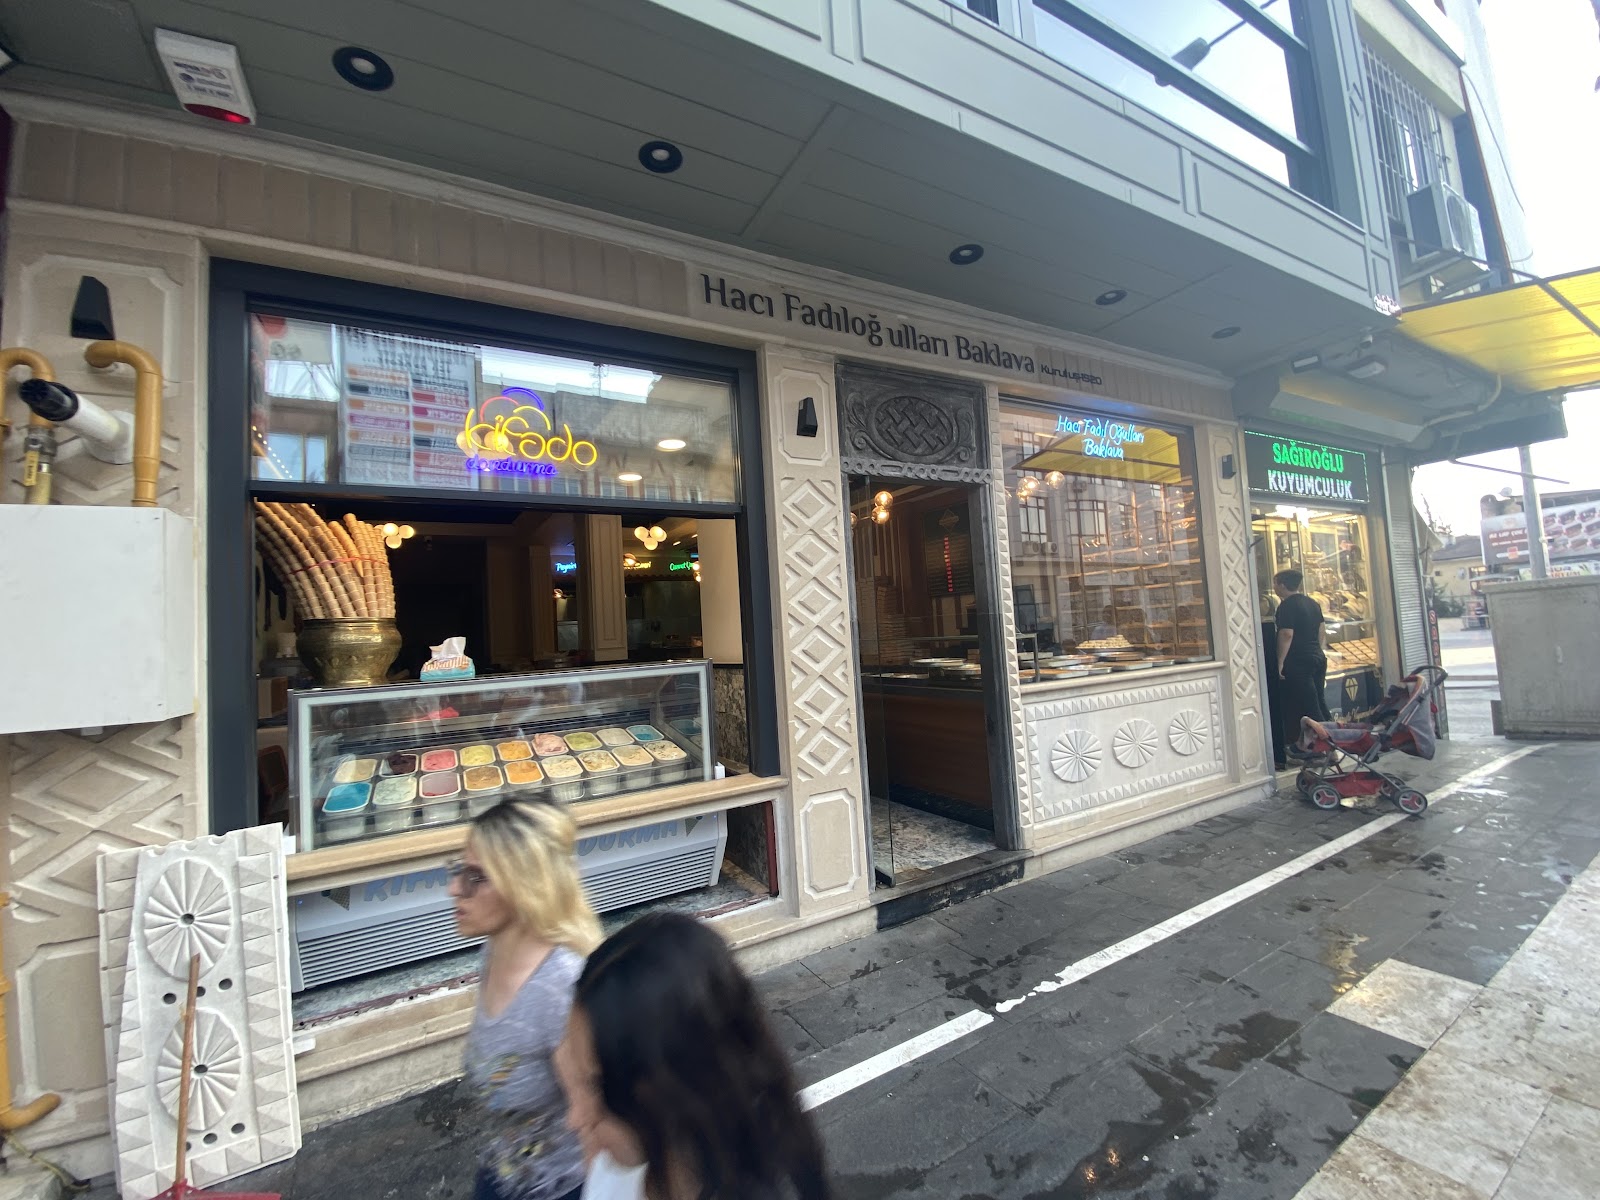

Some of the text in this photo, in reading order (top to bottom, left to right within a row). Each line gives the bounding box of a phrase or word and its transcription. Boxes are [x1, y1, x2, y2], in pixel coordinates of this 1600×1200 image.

[701, 273, 774, 318] Hacı
[955, 335, 1035, 373] Baklava
[1083, 438, 1124, 461] Baklava
[1267, 469, 1353, 499] KUYUMCULUK
